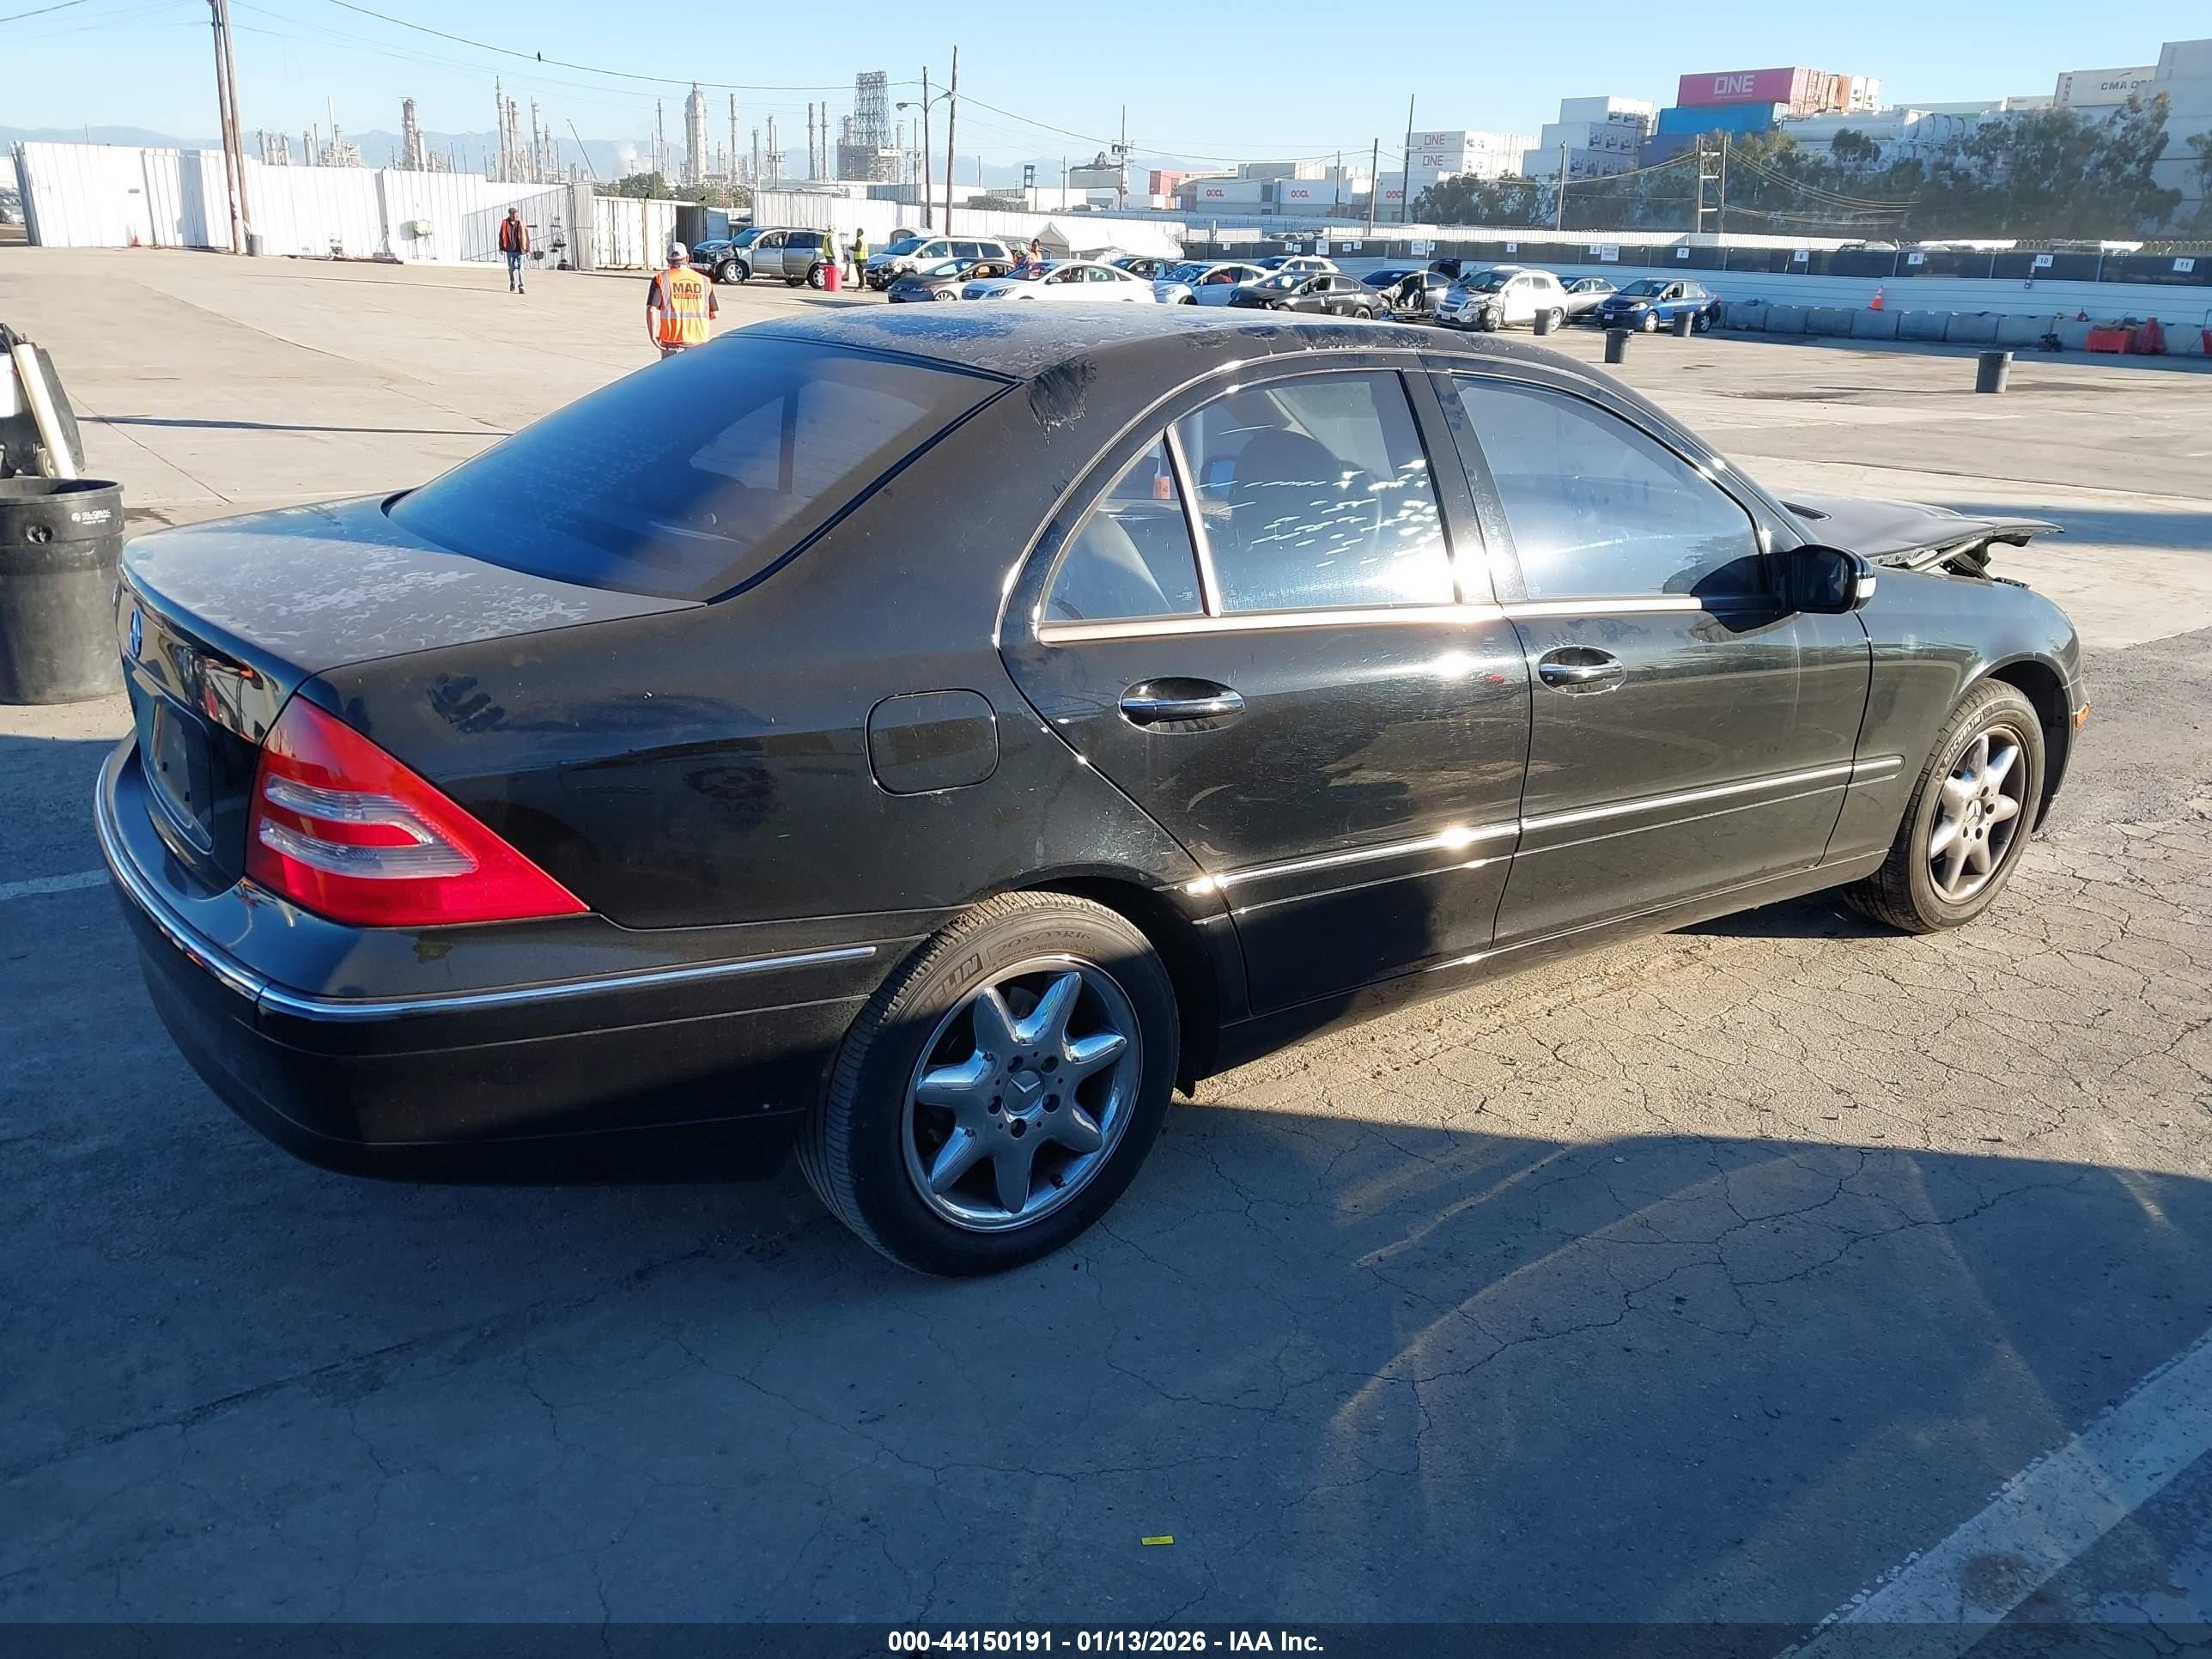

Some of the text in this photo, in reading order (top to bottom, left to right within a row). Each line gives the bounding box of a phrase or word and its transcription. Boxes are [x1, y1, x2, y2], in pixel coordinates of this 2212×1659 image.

[1713, 74, 1756, 94] ONE
[2100, 81, 2127, 90] CMA
[1424, 134, 1446, 145] ONE
[1422, 155, 1444, 167] ONE
[672, 283, 702, 294] MAD
